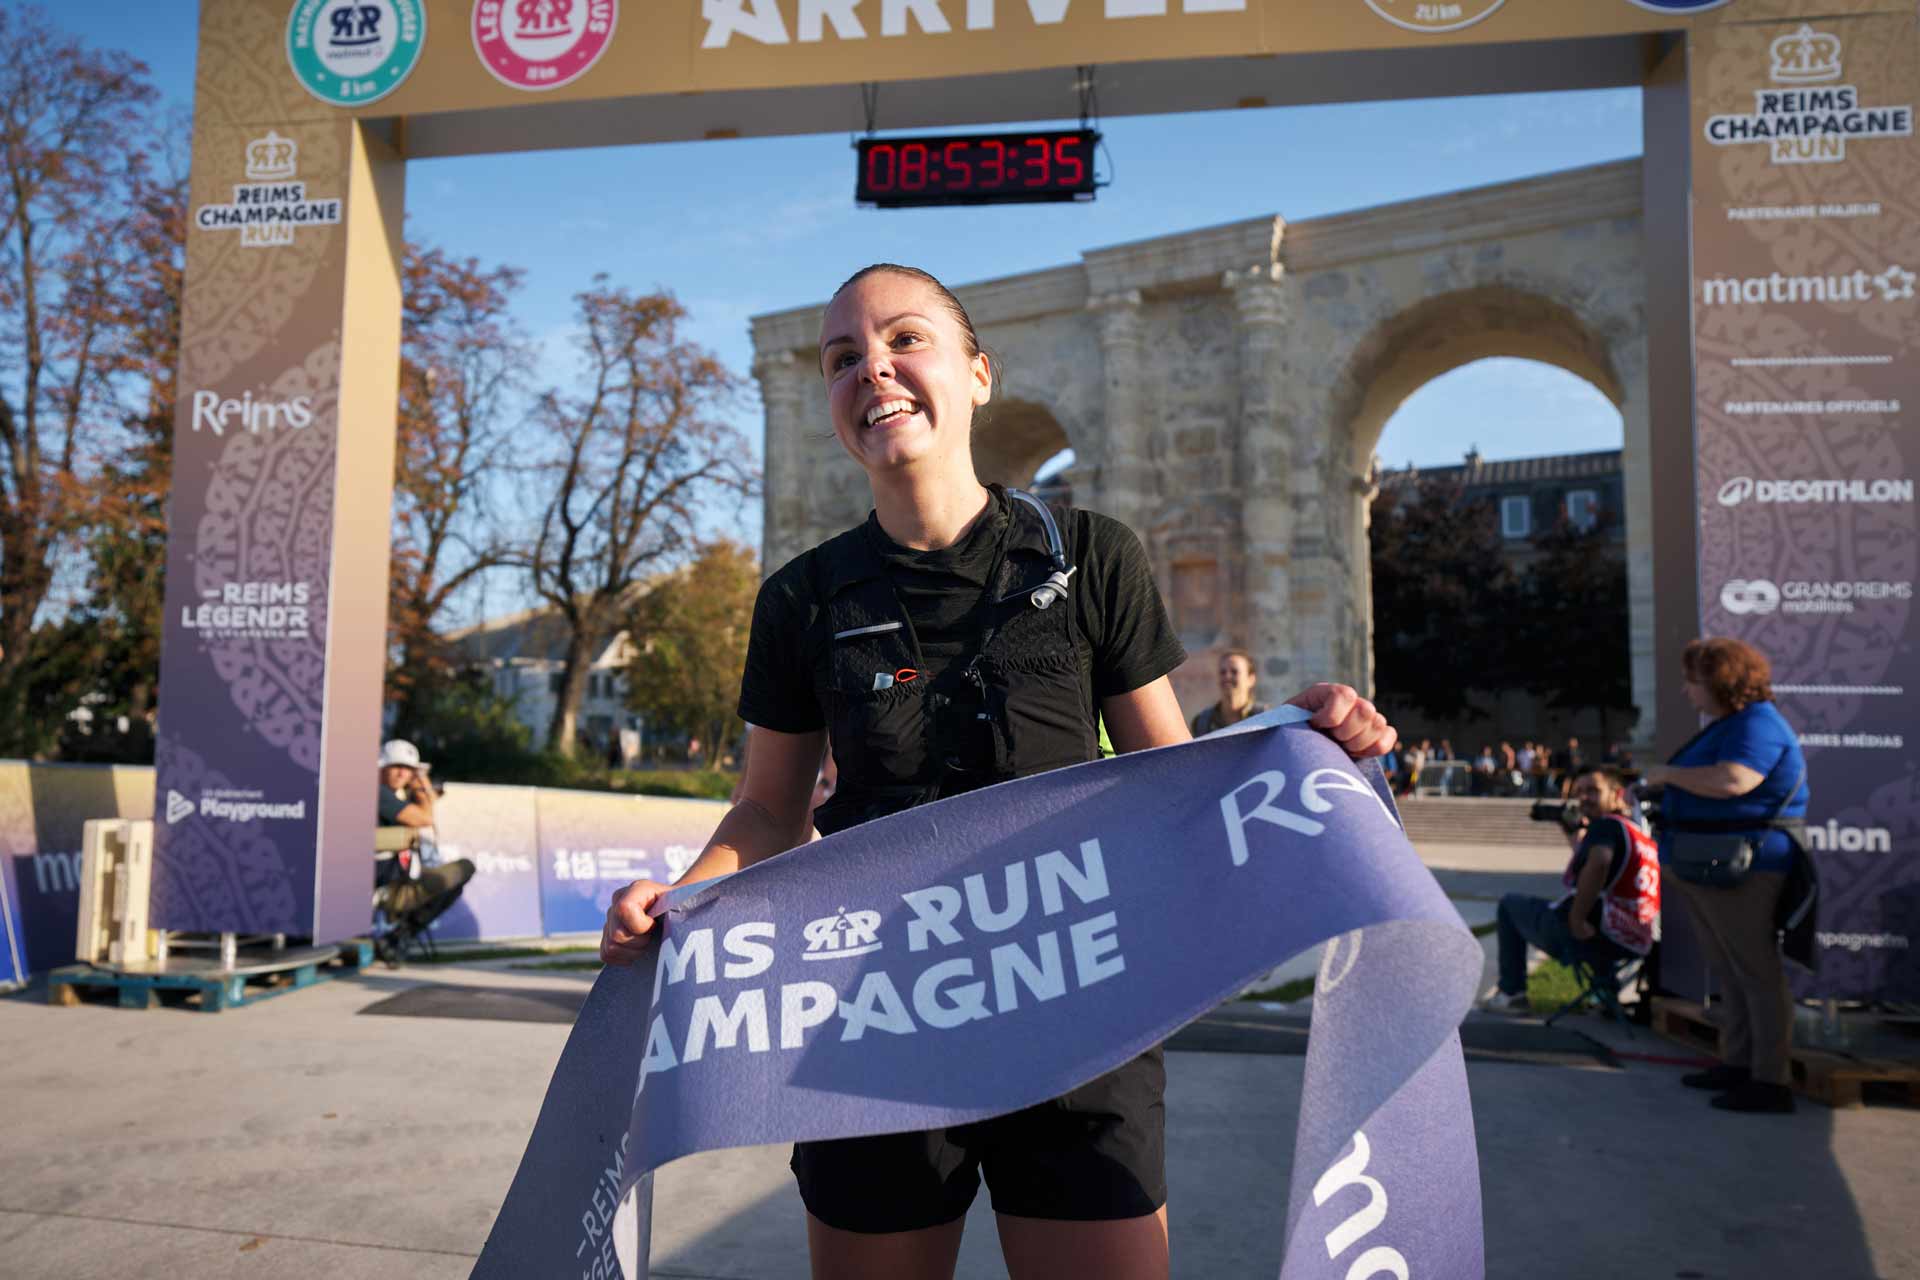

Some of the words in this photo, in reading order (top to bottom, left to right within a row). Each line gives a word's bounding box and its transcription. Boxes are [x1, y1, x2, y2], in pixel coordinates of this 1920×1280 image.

[1761, 89, 1853, 113] REIMS
[1709, 110, 1908, 140] CHAMPAGNE
[1776, 138, 1841, 158] RUN
[867, 137, 1084, 191] 08:53:35
[237, 185, 302, 205] REIMS
[199, 203, 338, 227] CHAMPAGNE
[244, 223, 290, 242] RUN
[1703, 272, 1872, 305] matmut
[192, 390, 313, 436] Reims
[1756, 480, 1914, 502] DECATHLON
[1781, 581, 1852, 600] GRAND
[1855, 581, 1913, 600] REIMS
[1799, 733, 1841, 748] AIRES
[1843, 733, 1903, 748] MÉDIAS
[200, 797, 305, 823] Playground
[1220, 768, 1398, 867] Re
[1804, 819, 1891, 852] nion
[901, 838, 1110, 953] RUN
[638, 911, 1126, 1077] AMPAGNE
